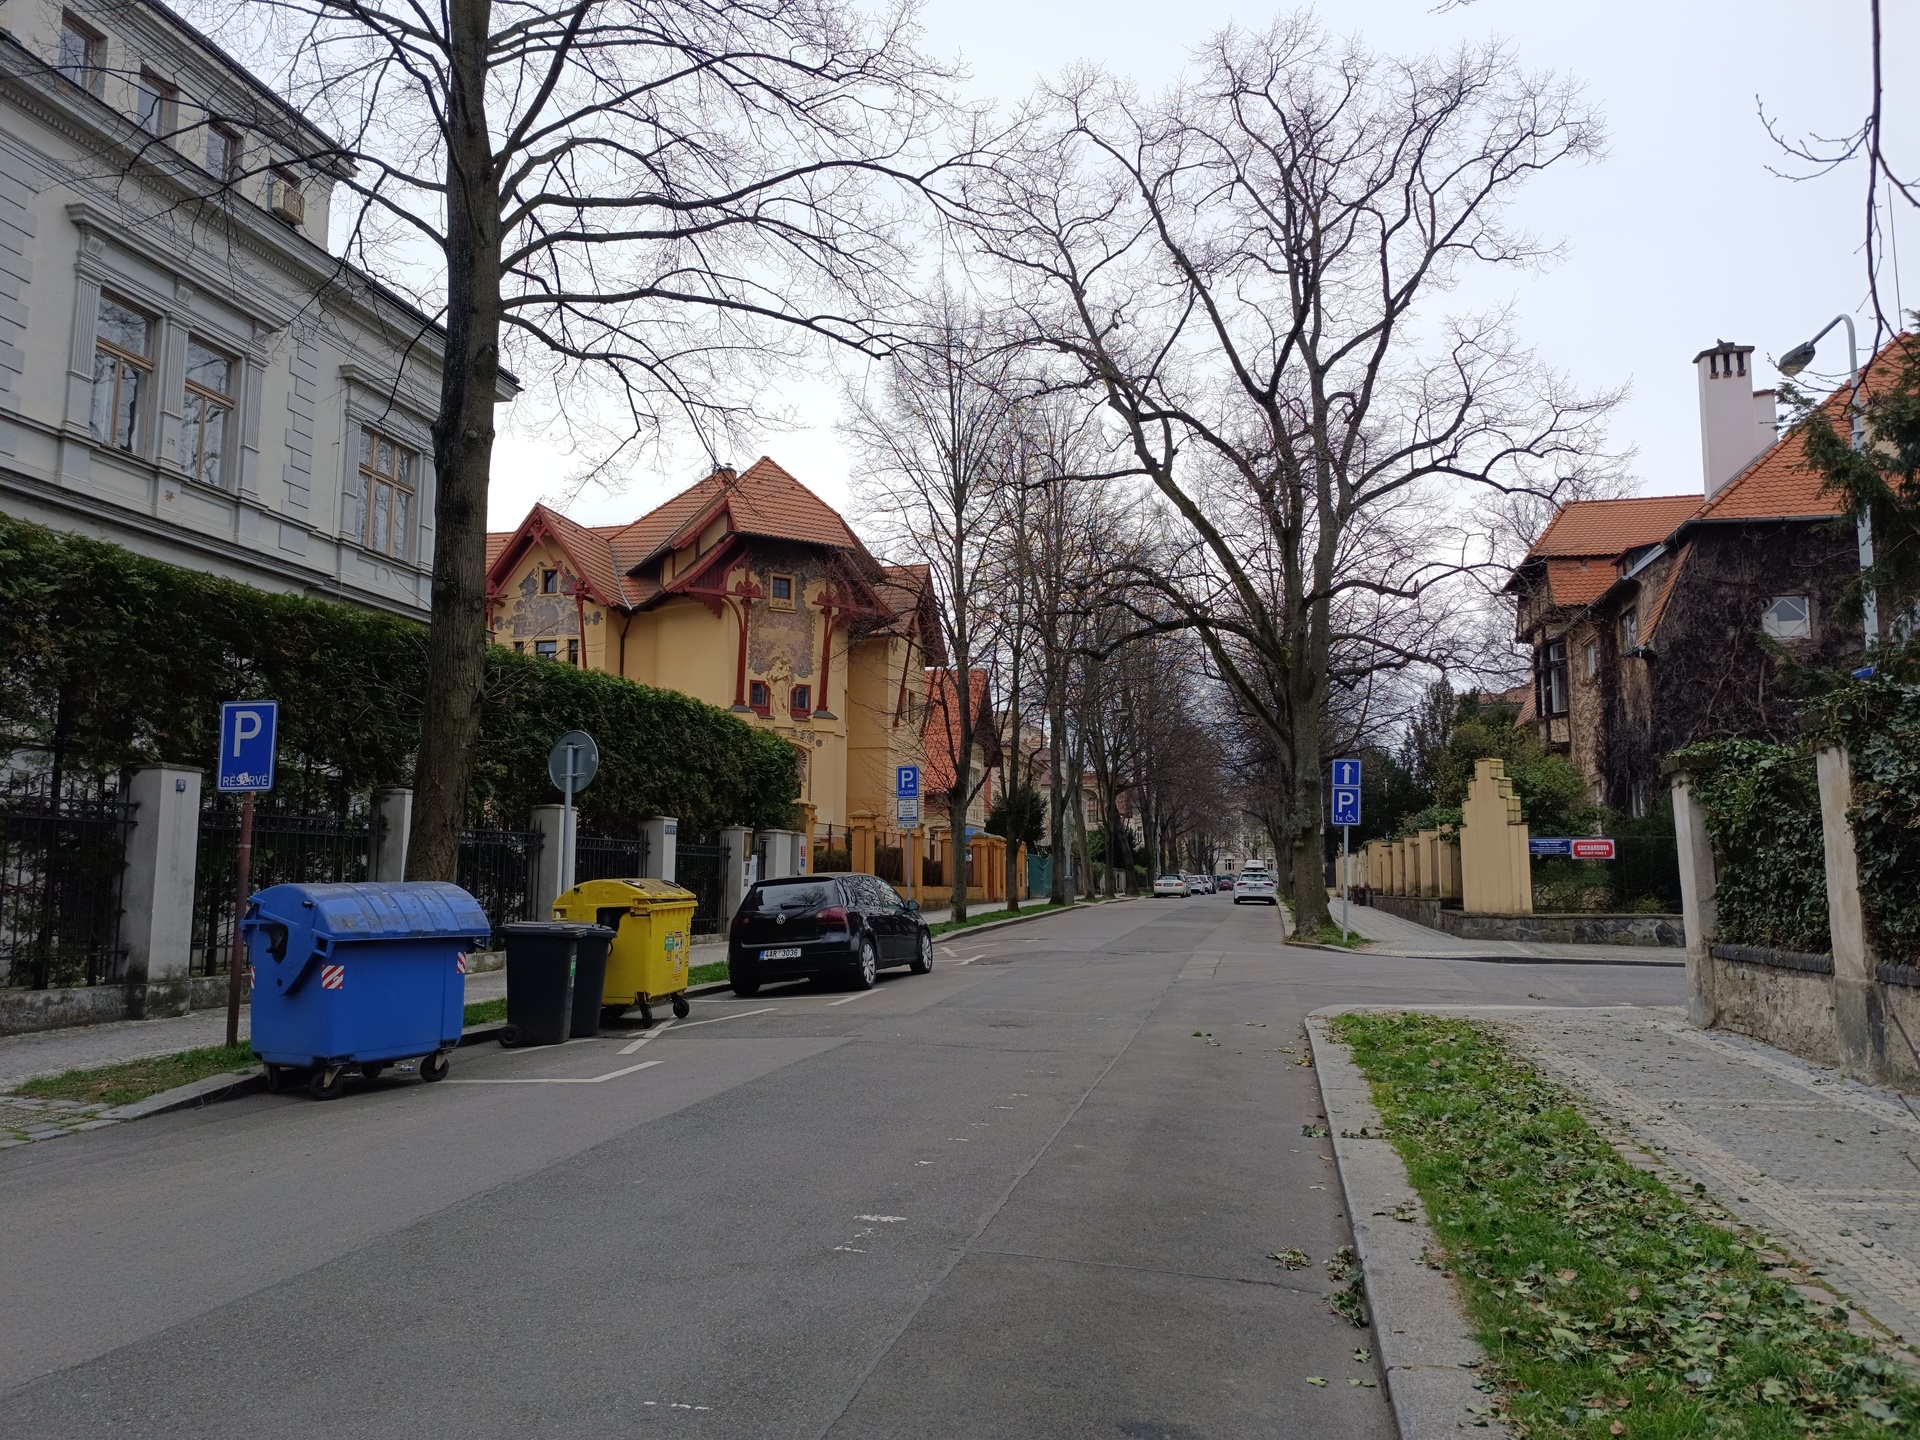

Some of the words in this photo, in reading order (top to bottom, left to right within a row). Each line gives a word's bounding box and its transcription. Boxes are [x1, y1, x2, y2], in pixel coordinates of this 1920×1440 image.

[233, 711, 262, 757] P
[901, 770, 914, 788] P
[1338, 791, 1354, 813] P
[1335, 814, 1343, 822] 1x
[781, 948, 799, 957] 3036
